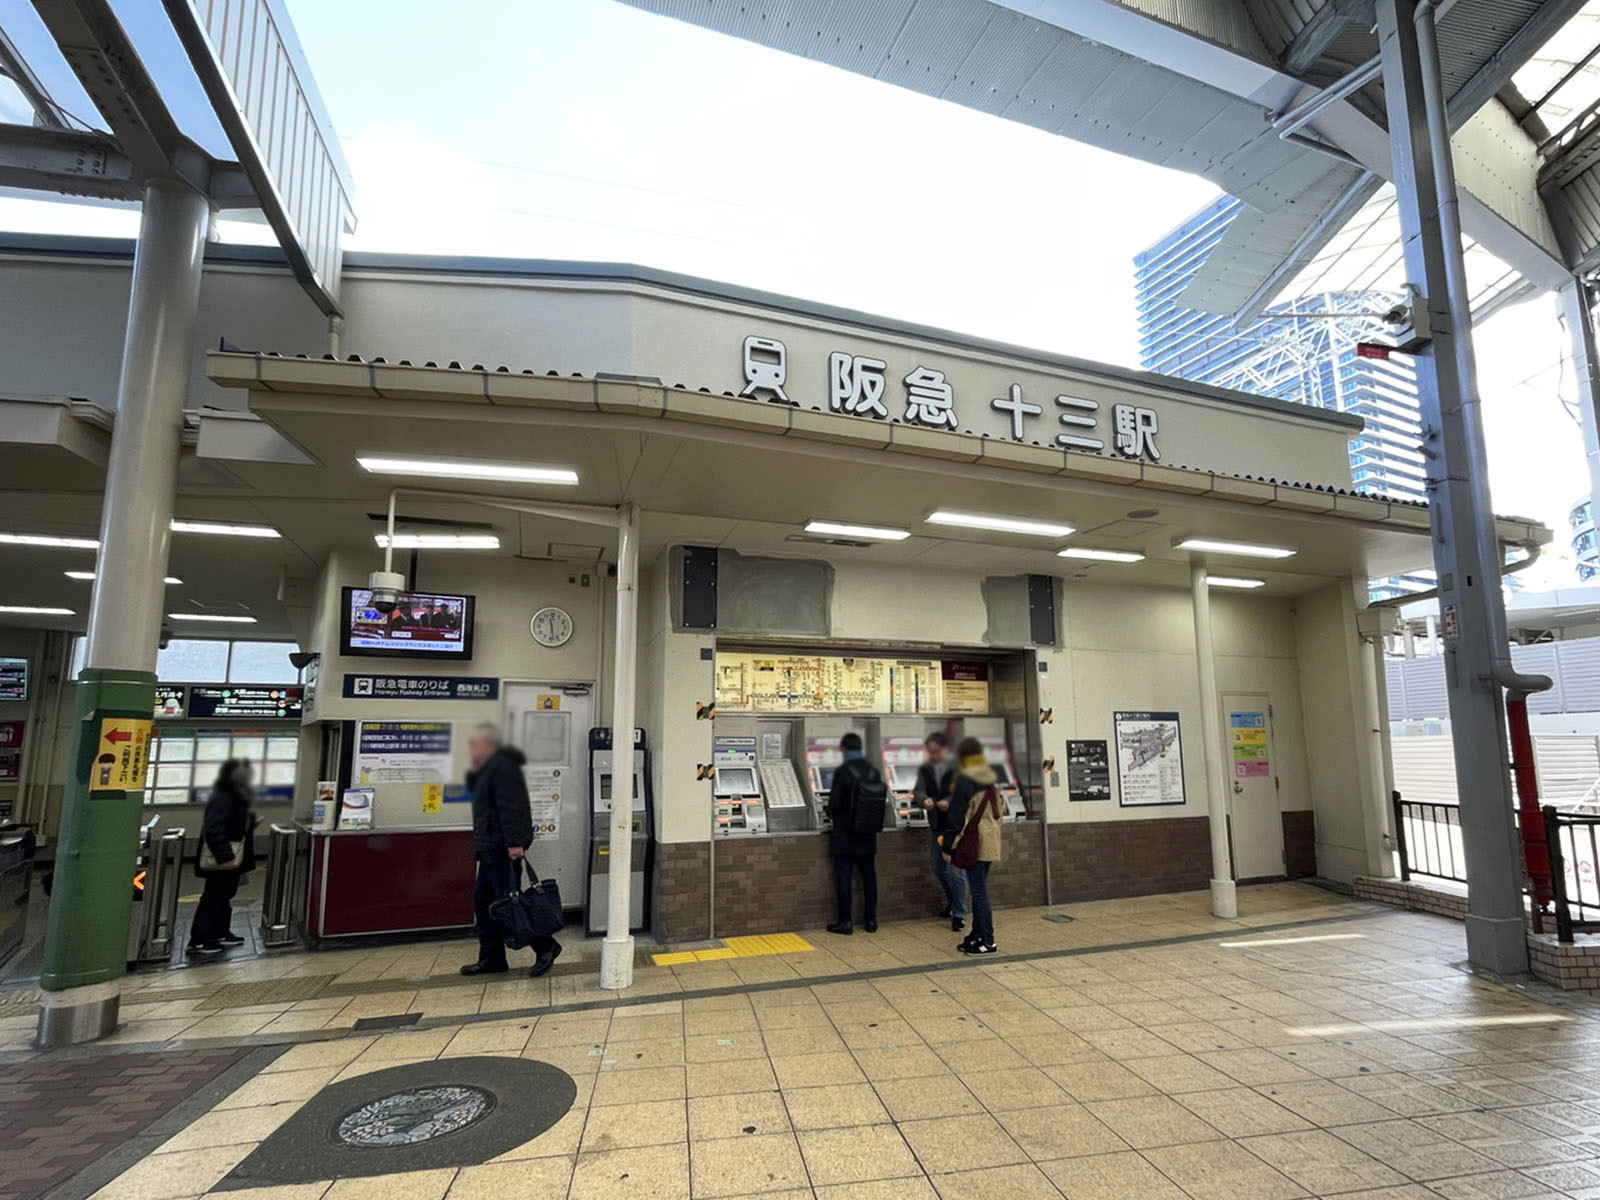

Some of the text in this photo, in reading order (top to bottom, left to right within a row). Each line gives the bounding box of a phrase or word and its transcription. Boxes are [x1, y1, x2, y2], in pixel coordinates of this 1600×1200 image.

[829, 351, 1162, 460] 阪急 十三駅
[375, 679, 450, 690] 阪急電車のりば
